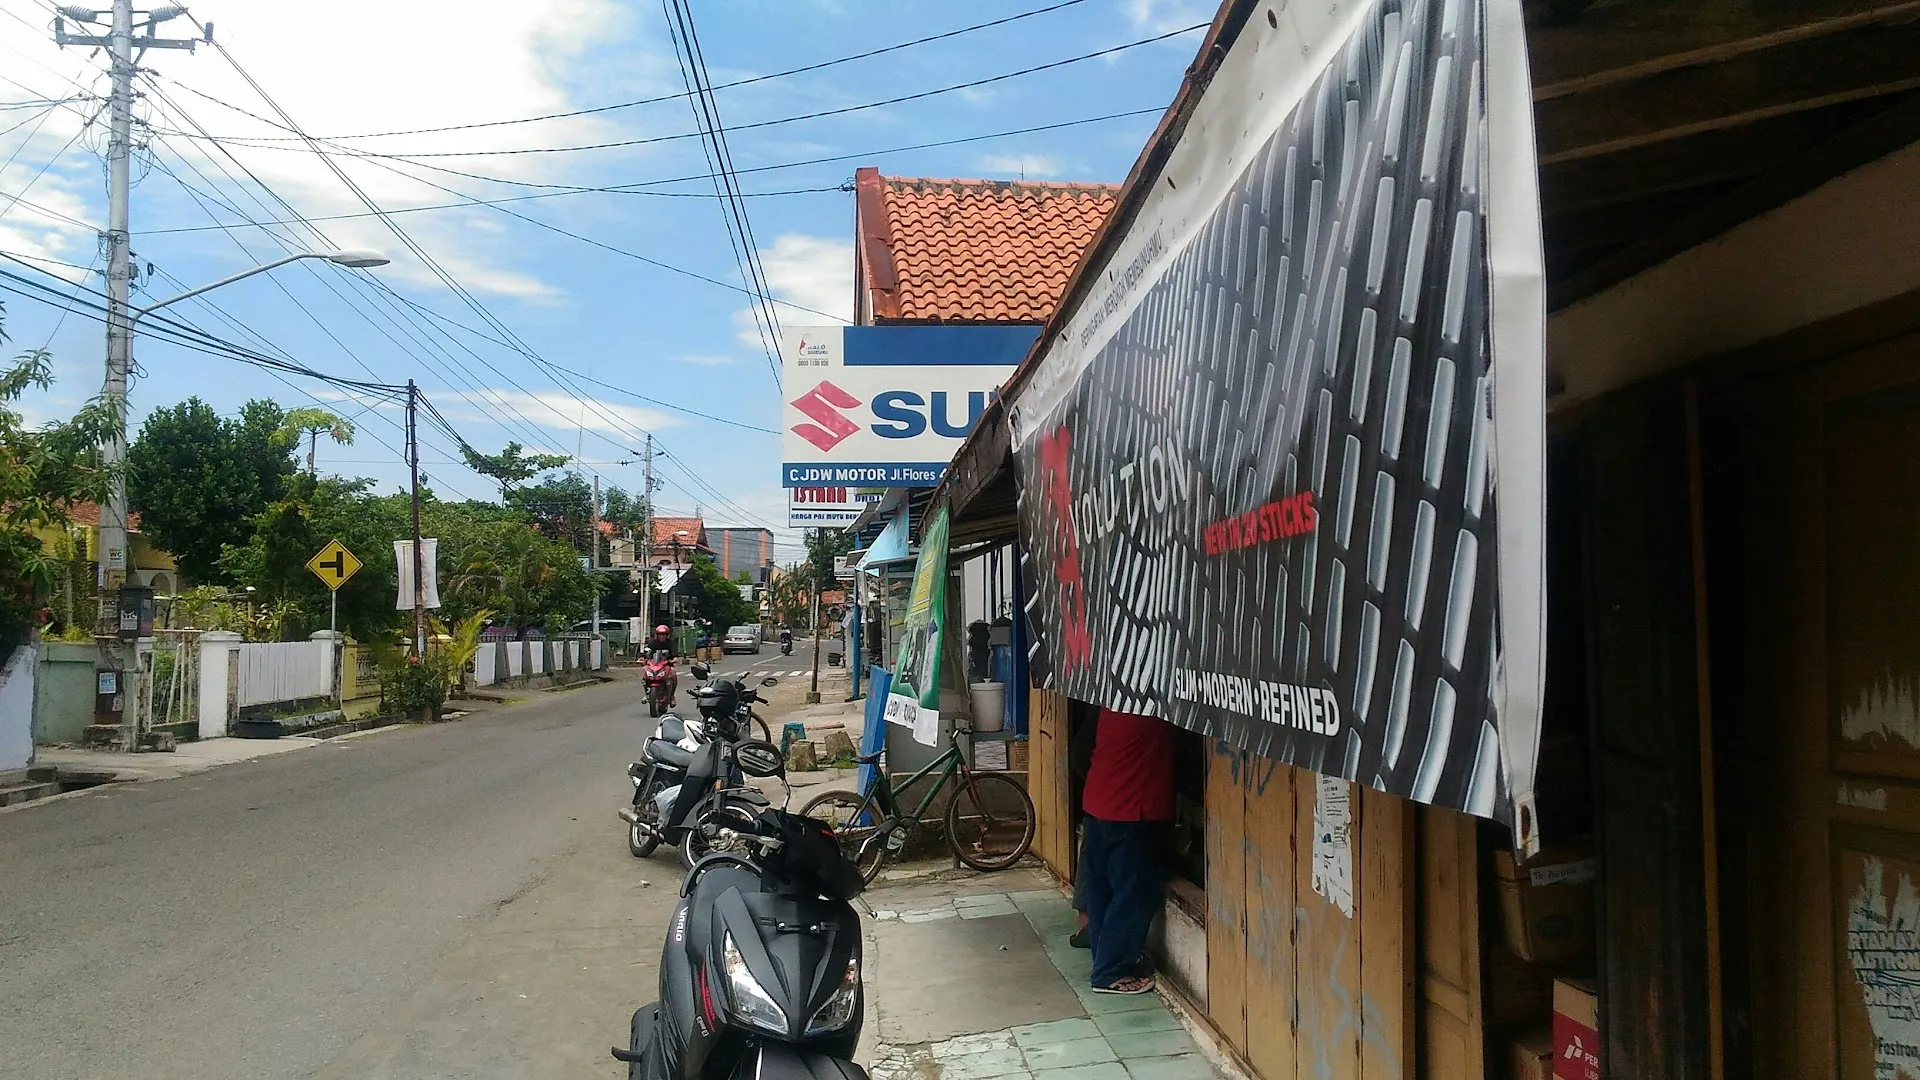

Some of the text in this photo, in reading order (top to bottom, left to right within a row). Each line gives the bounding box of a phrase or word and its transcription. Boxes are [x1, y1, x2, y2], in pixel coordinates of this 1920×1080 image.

[871, 390, 998, 439] SU
[793, 486, 847, 503] ISTANA
[836, 468, 886, 481] MOTOR
[1204, 519, 1226, 556] NEW
[1260, 490, 1316, 543] STICKS
[1175, 667, 1340, 737] SLIM MODERN REFINED
